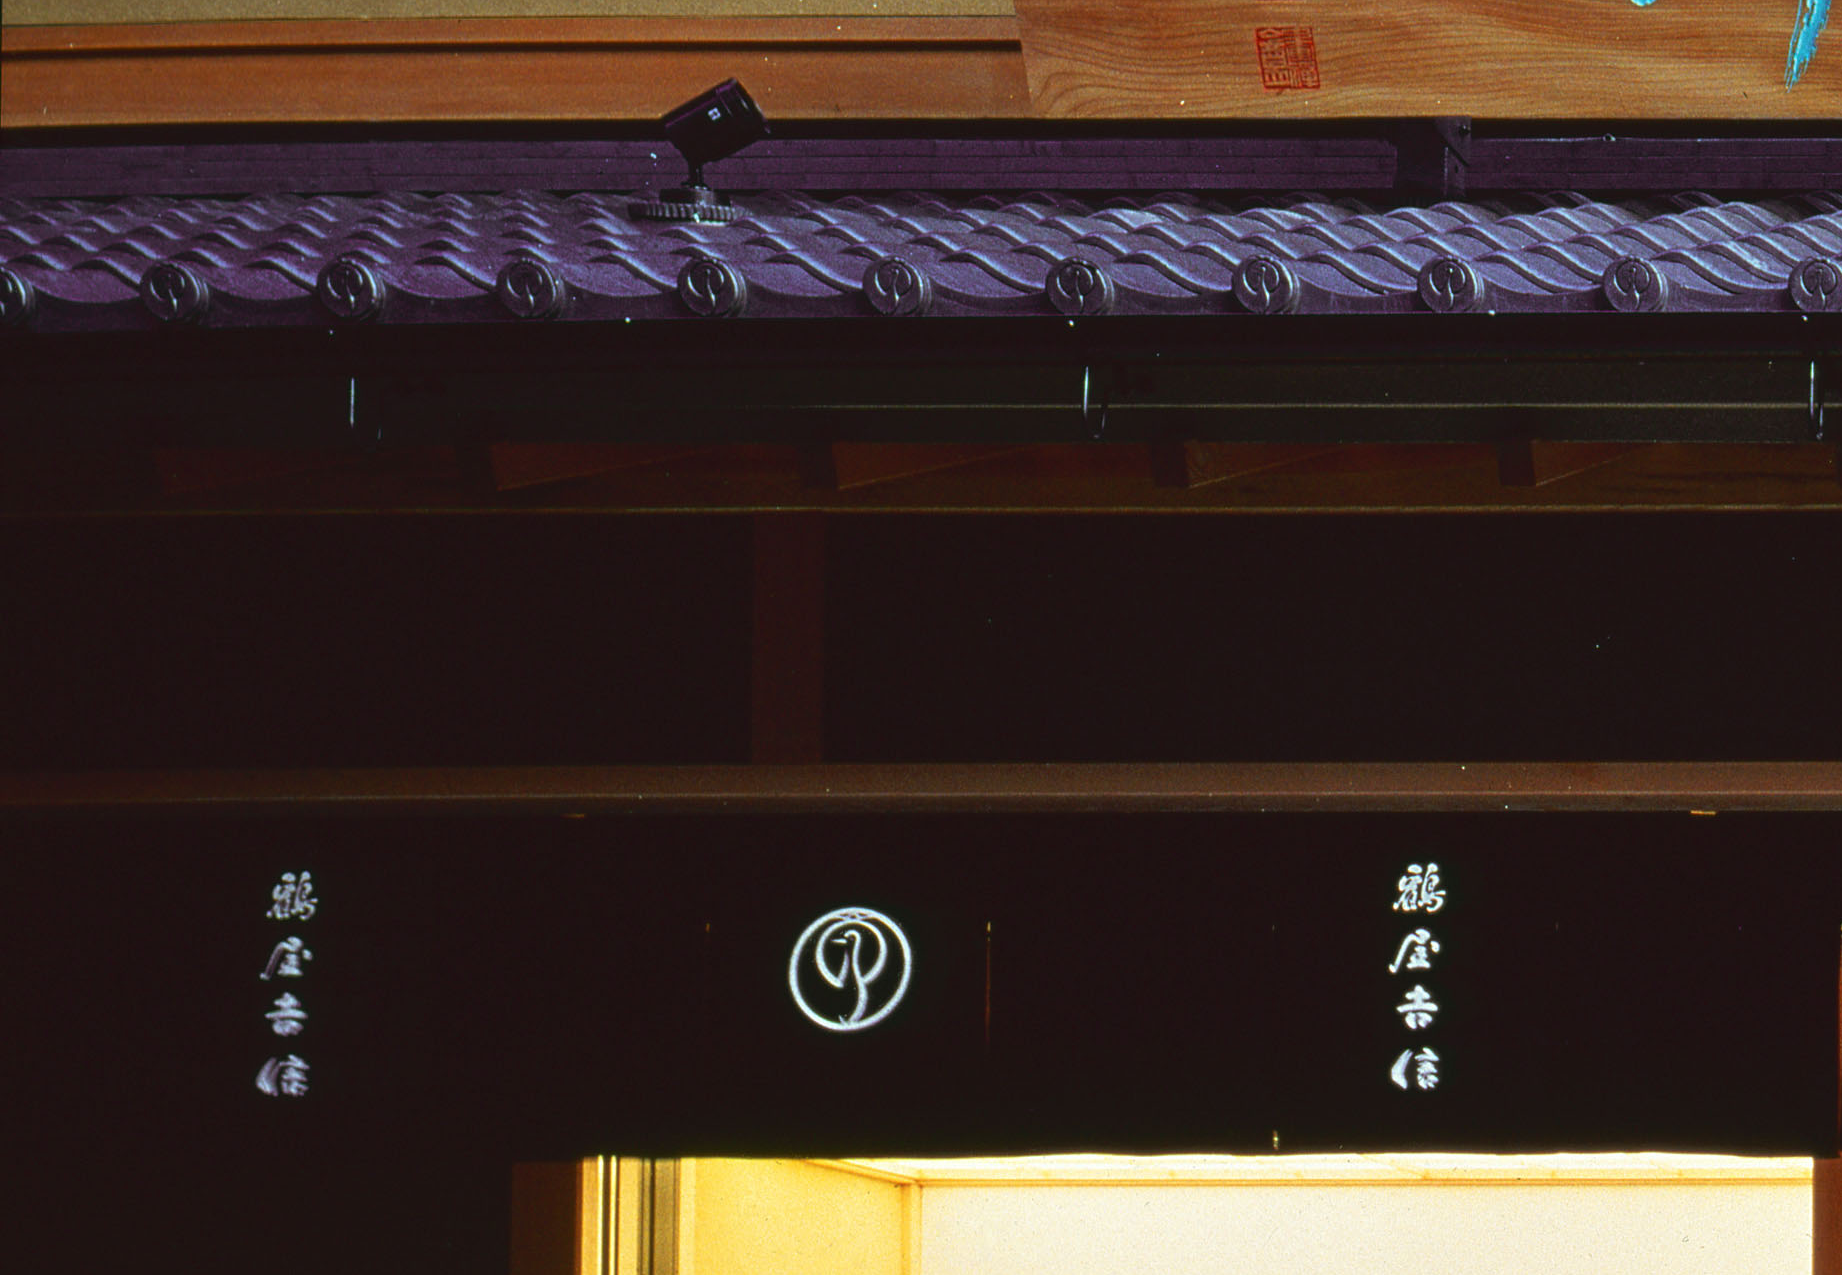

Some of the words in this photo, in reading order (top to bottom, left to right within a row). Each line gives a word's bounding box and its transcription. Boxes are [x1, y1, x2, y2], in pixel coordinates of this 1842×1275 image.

[254, 869, 319, 1098] 鶴屋吉信
[1387, 861, 1448, 1091] 鶴屋吉信
